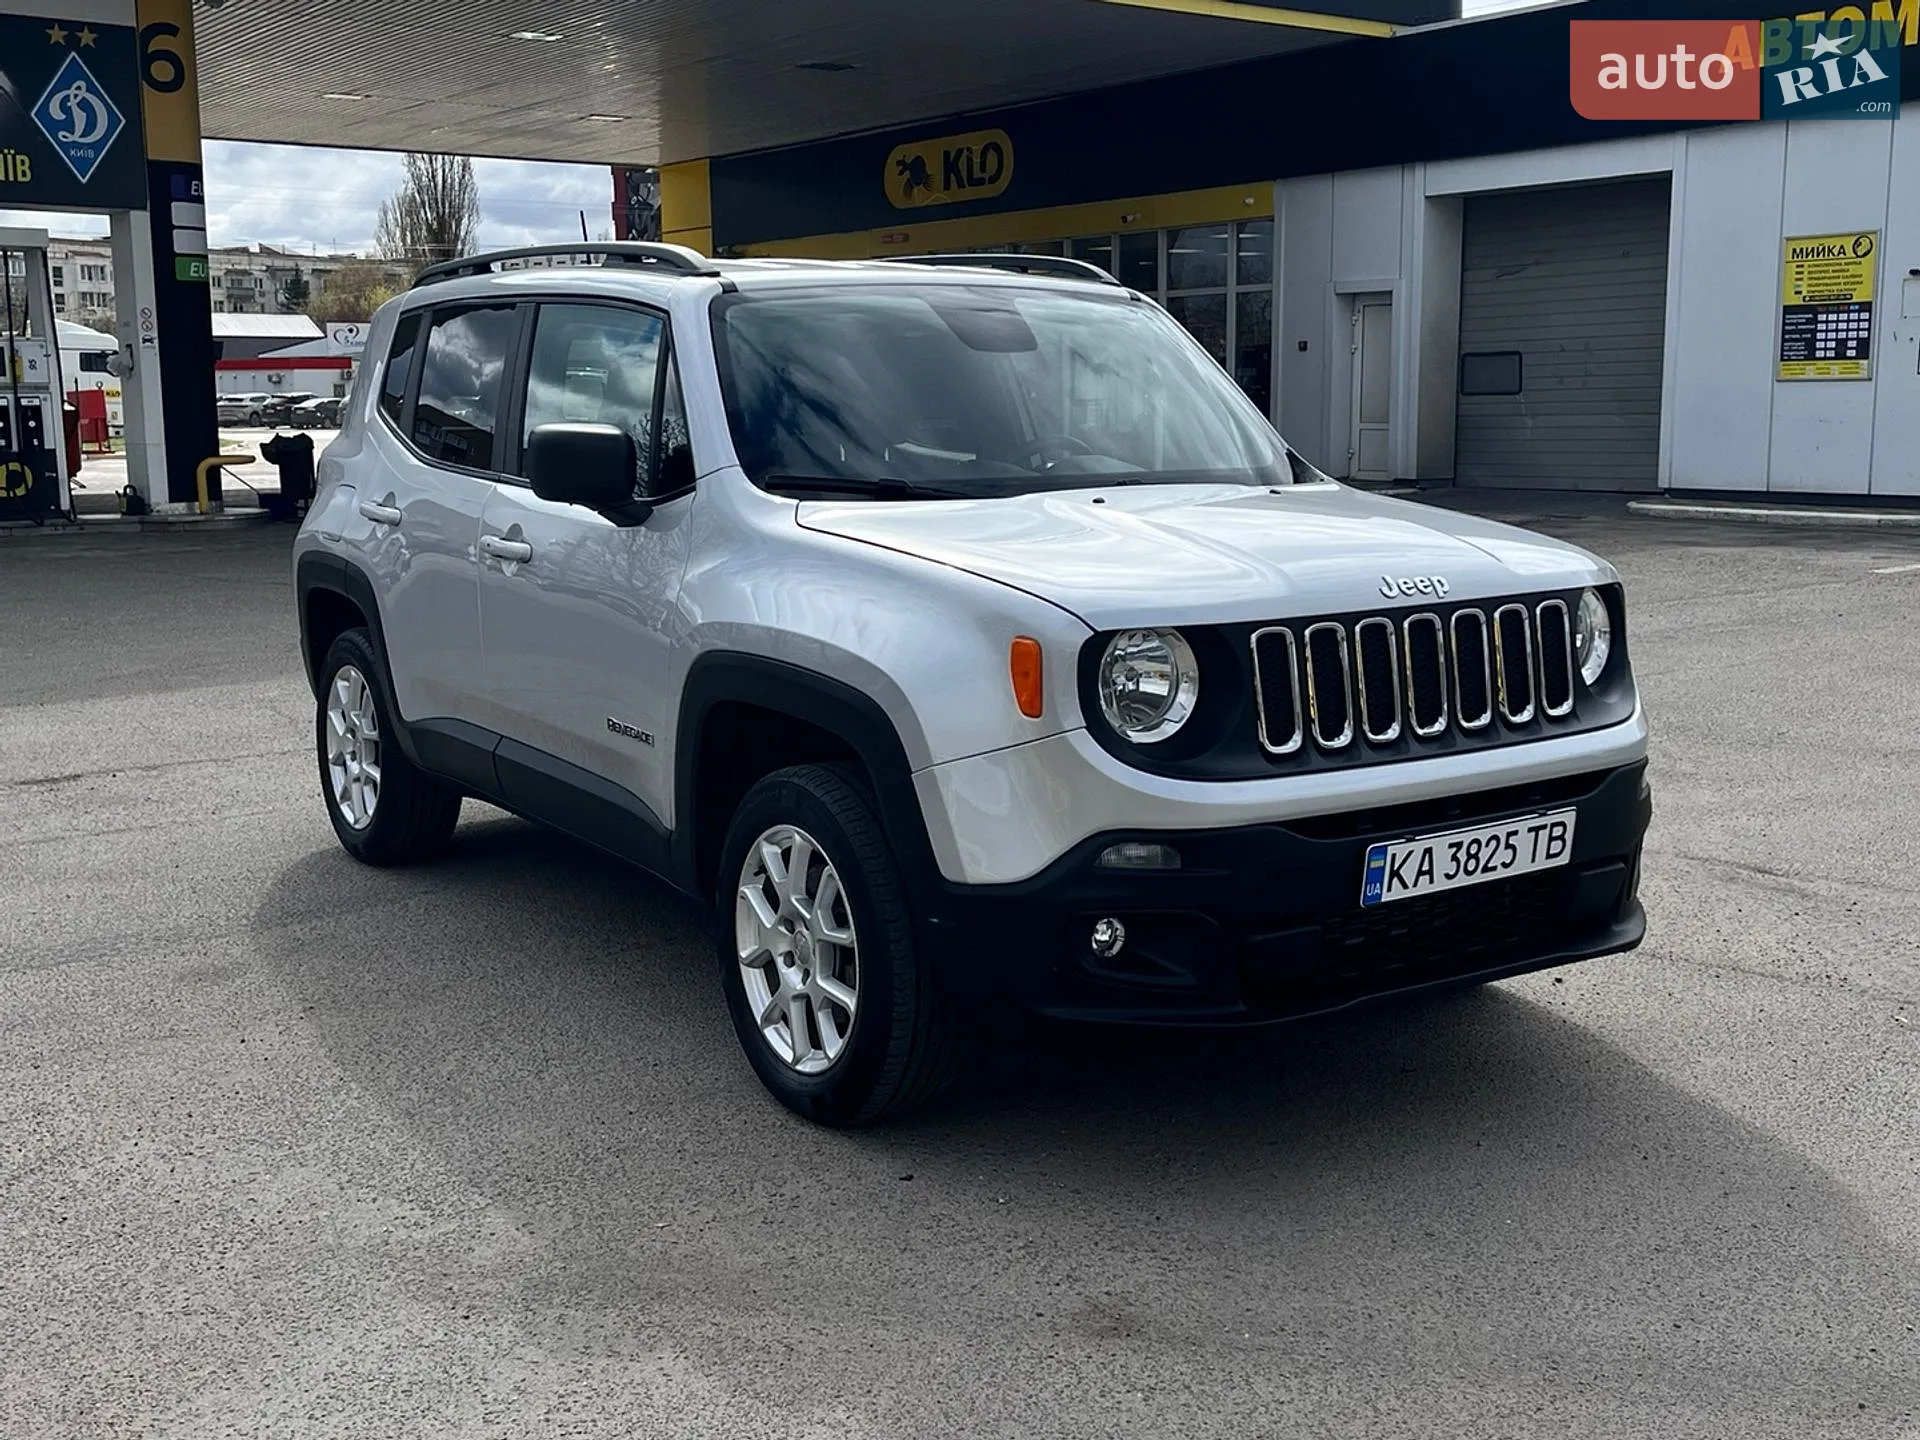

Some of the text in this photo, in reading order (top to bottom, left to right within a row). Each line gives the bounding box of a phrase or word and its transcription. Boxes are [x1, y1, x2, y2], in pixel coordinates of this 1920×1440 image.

[140, 22, 186, 93] 6
[942, 141, 1004, 191] KLO
[1791, 243, 1847, 259] МИЙКА
[1379, 574, 1450, 600] Jeep
[1387, 820, 1568, 892] KA 3825 TB
[1366, 882, 1381, 896] UA
